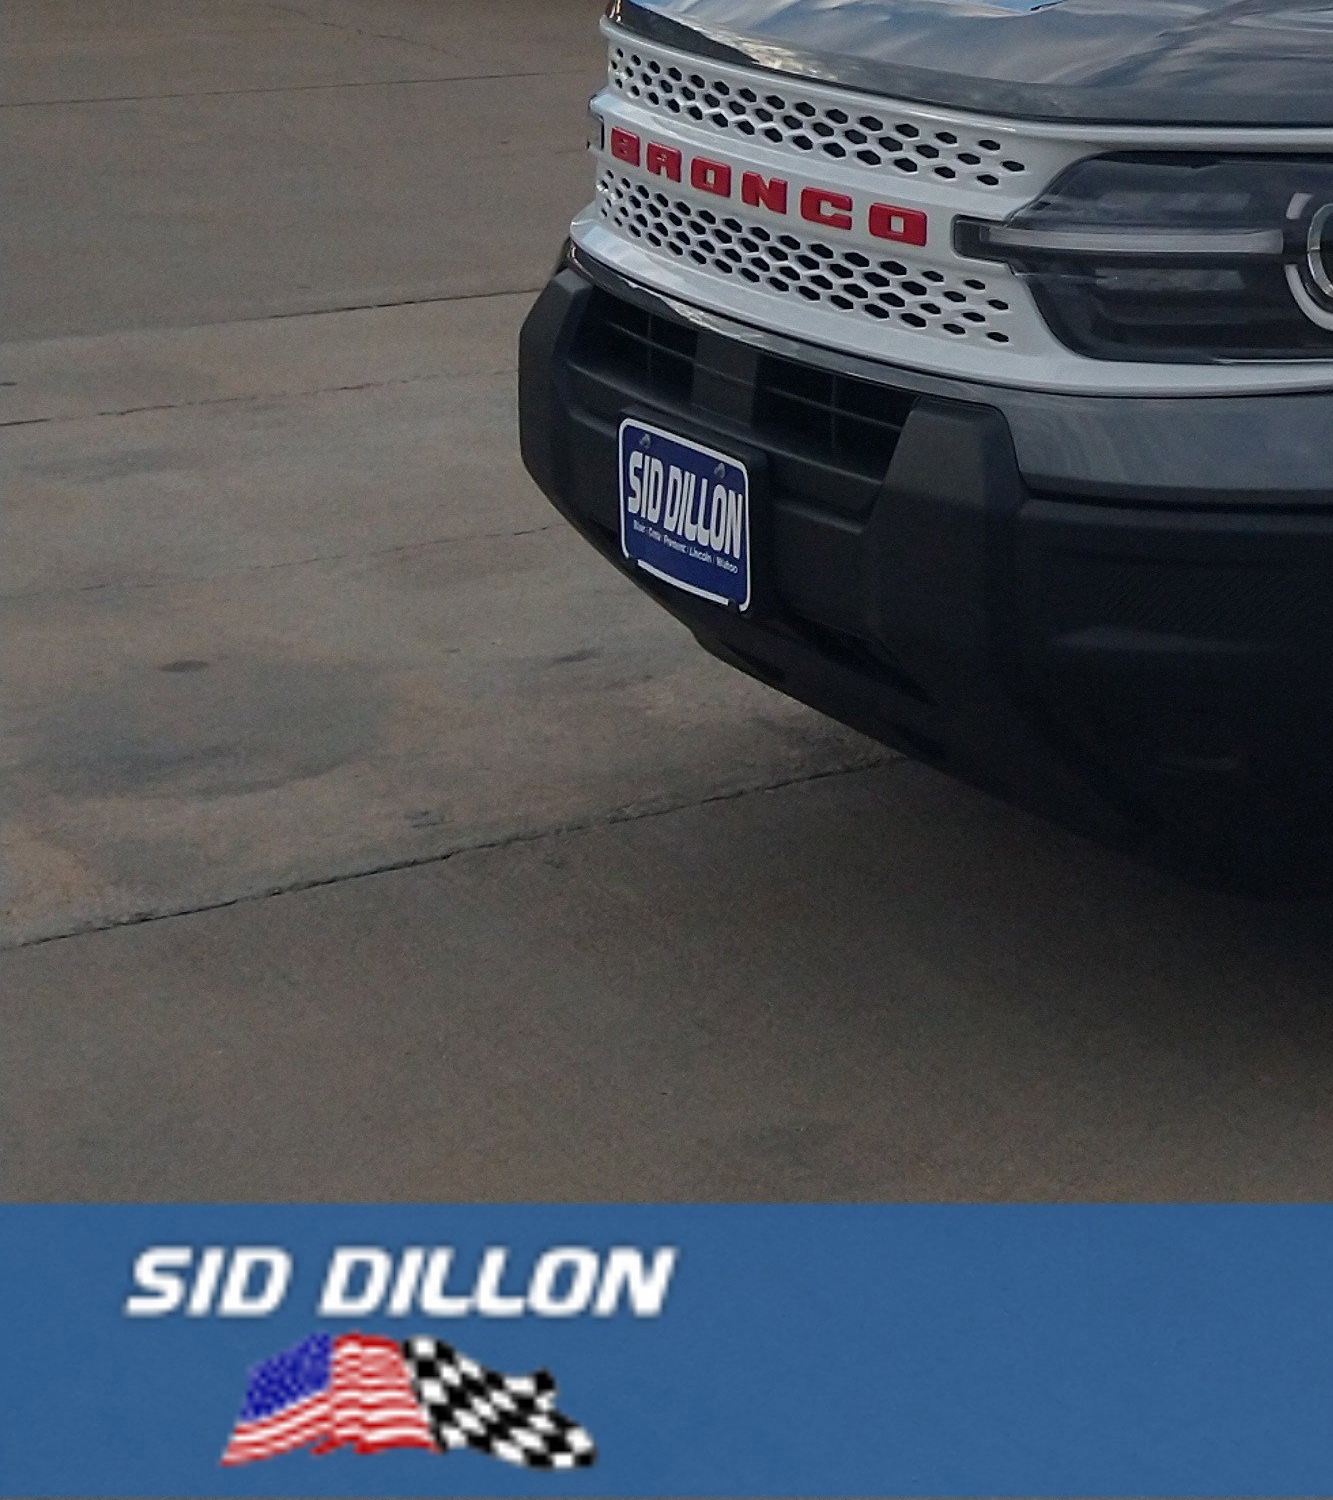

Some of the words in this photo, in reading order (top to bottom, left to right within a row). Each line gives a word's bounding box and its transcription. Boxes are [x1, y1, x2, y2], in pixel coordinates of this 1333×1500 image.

[610, 126, 928, 247] BRONCO
[628, 450, 664, 524] SID
[663, 464, 743, 560] DILLON
